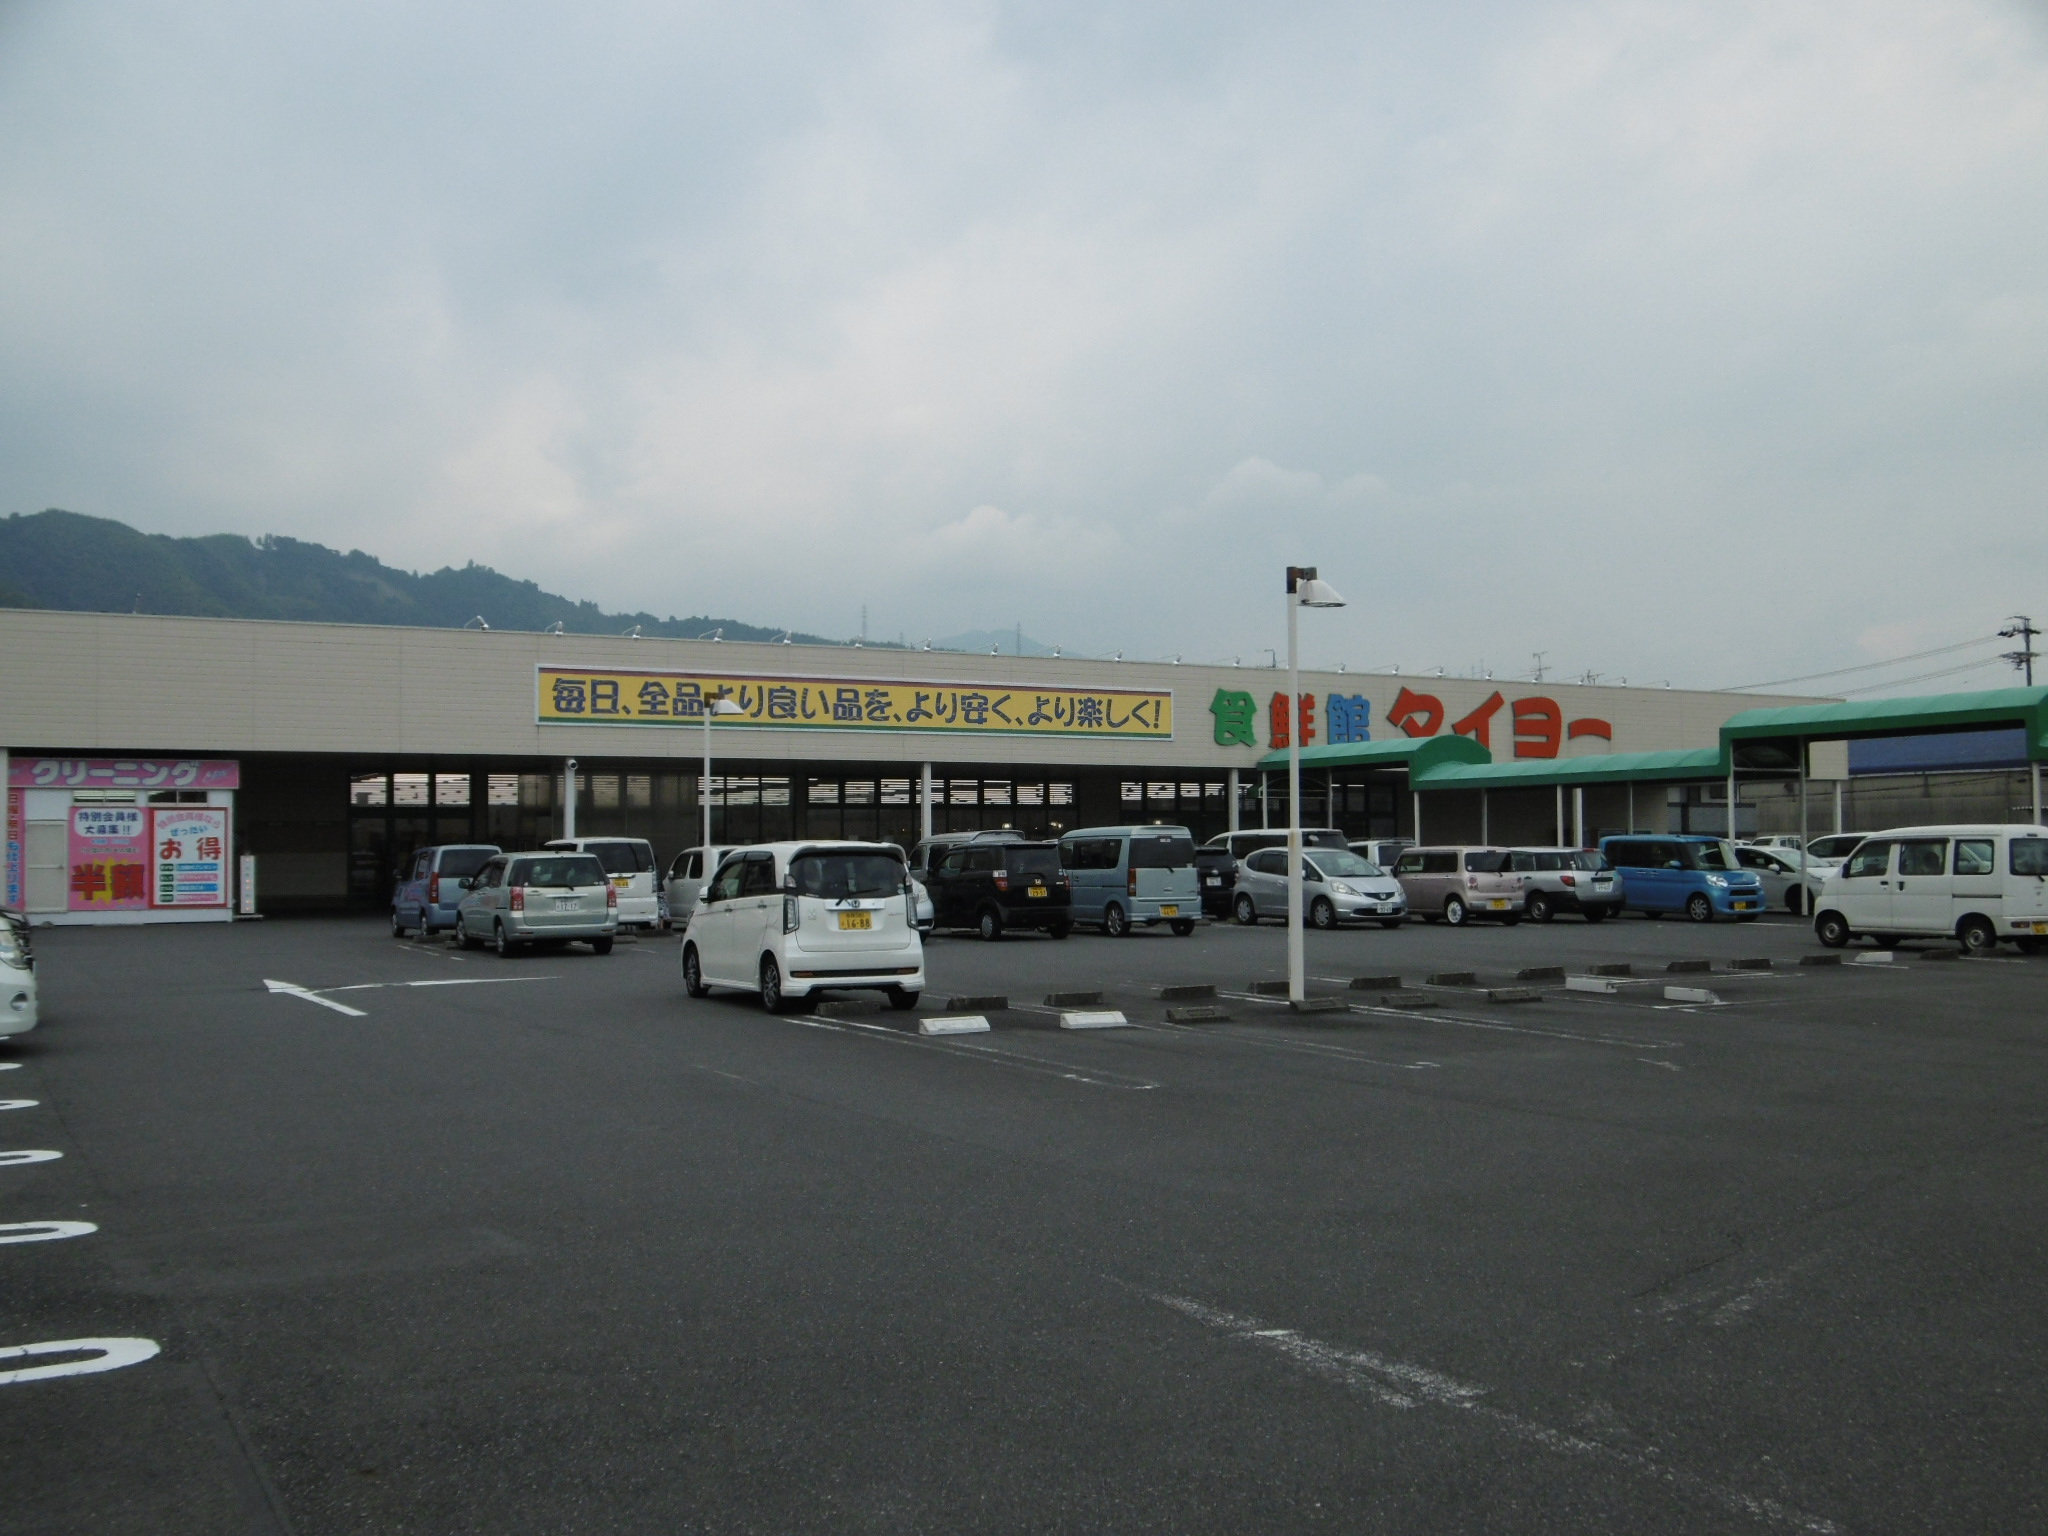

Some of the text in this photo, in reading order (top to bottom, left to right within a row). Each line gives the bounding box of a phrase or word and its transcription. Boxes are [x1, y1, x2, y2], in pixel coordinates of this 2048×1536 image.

[32, 760, 199, 785] クリーニング
[846, 919, 871, 928] 16-88
